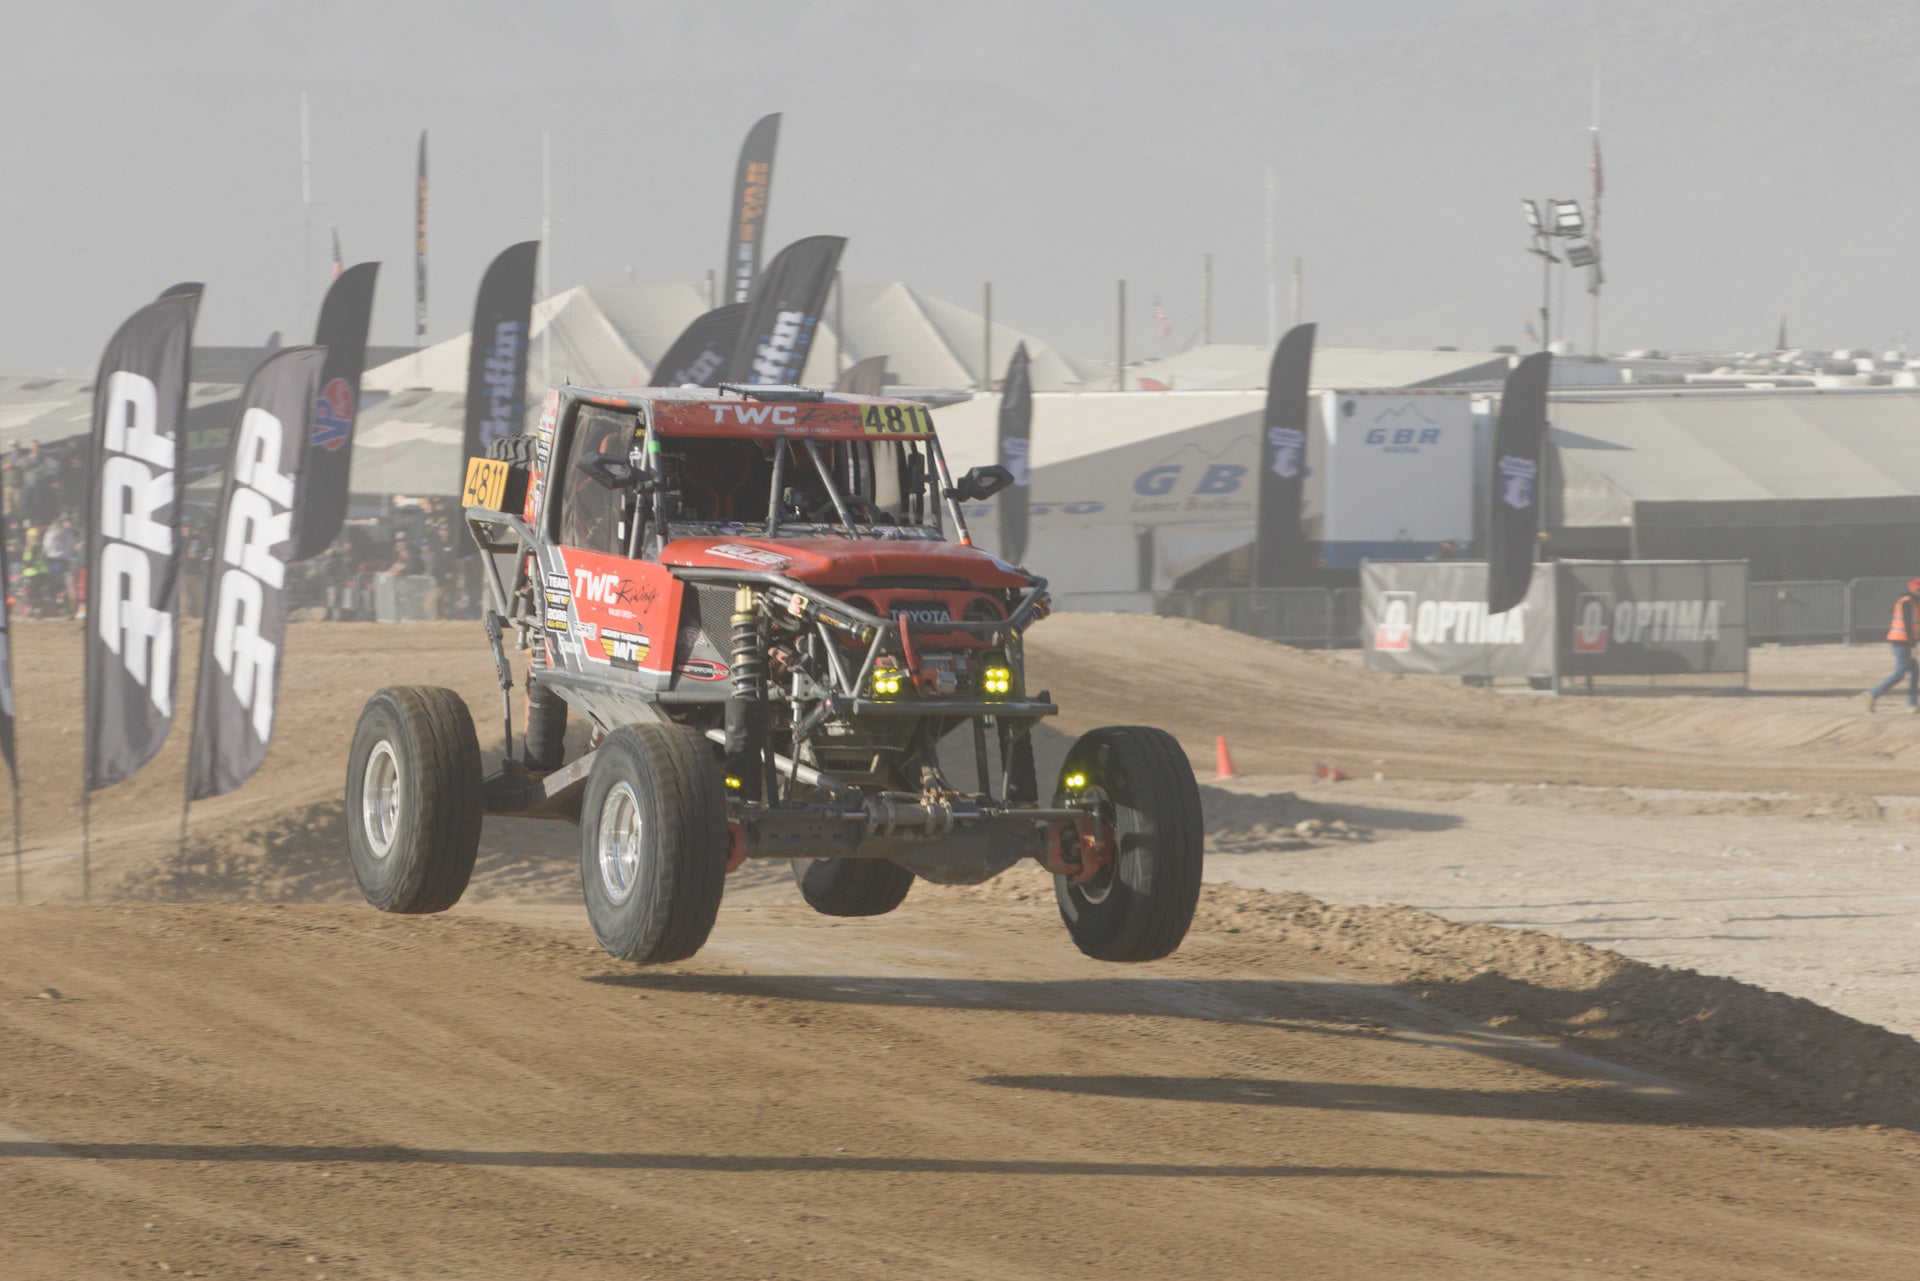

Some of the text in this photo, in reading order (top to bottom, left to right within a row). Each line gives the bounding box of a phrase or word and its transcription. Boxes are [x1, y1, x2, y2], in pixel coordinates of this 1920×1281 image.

[310, 396, 352, 447] VP
[708, 405, 798, 425] TWC
[865, 405, 936, 433] 4811
[1365, 428, 1441, 445] GBR
[468, 461, 505, 508] 4811
[100, 370, 176, 719] PRP
[213, 407, 296, 745] PRP
[574, 568, 619, 605] TWC
[890, 609, 950, 623] TOYOTA
[1416, 600, 1525, 645] OPTIMA
[1613, 600, 1720, 645] OPTIMA
